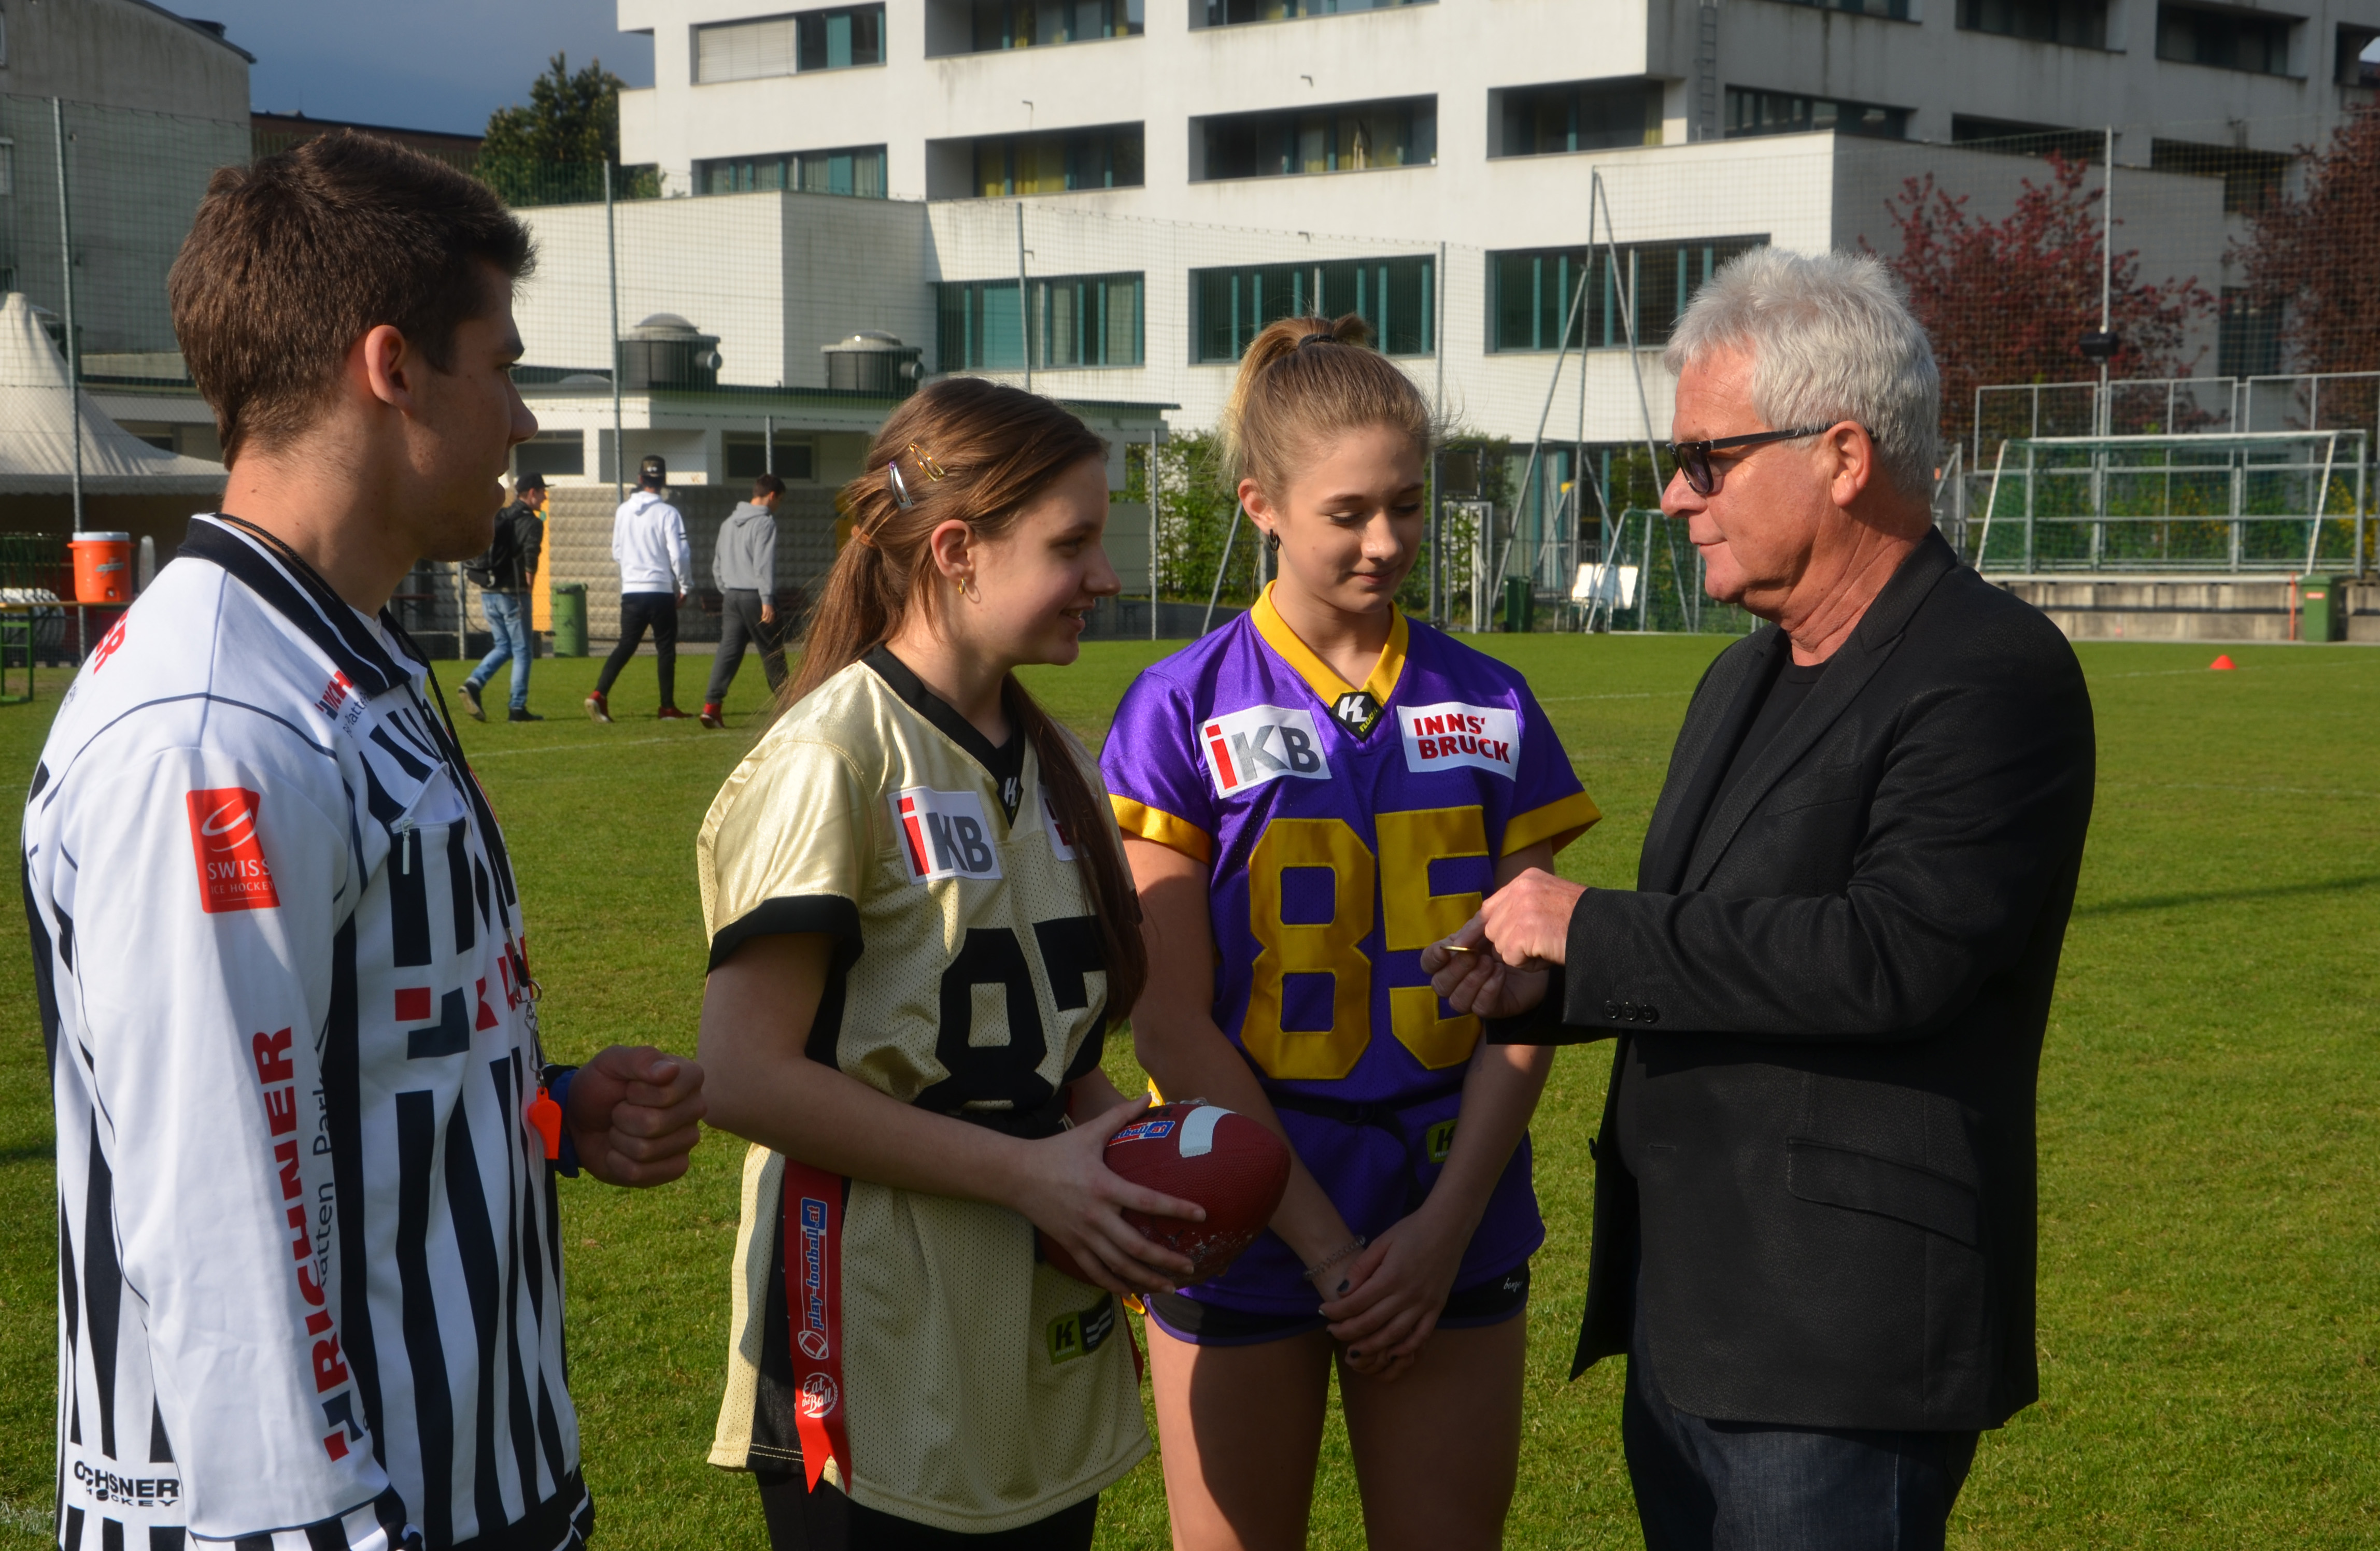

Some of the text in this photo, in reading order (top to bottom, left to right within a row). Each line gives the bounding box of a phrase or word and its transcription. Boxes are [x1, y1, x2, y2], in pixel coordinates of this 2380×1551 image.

[1413, 714, 1486, 737] INNS'
[1205, 724, 1321, 790] iKB
[1418, 734, 1511, 764] BRUCK
[897, 796, 993, 877] iKB
[208, 859, 272, 880] SWISS
[211, 881, 274, 894] ICE HOCKEY
[1241, 805, 1490, 1080] 85
[252, 1027, 349, 1394] RICHNER
[802, 1377, 825, 1398] Eat
[805, 1387, 833, 1414] Ball
[74, 1460, 180, 1498] OCHSNER
